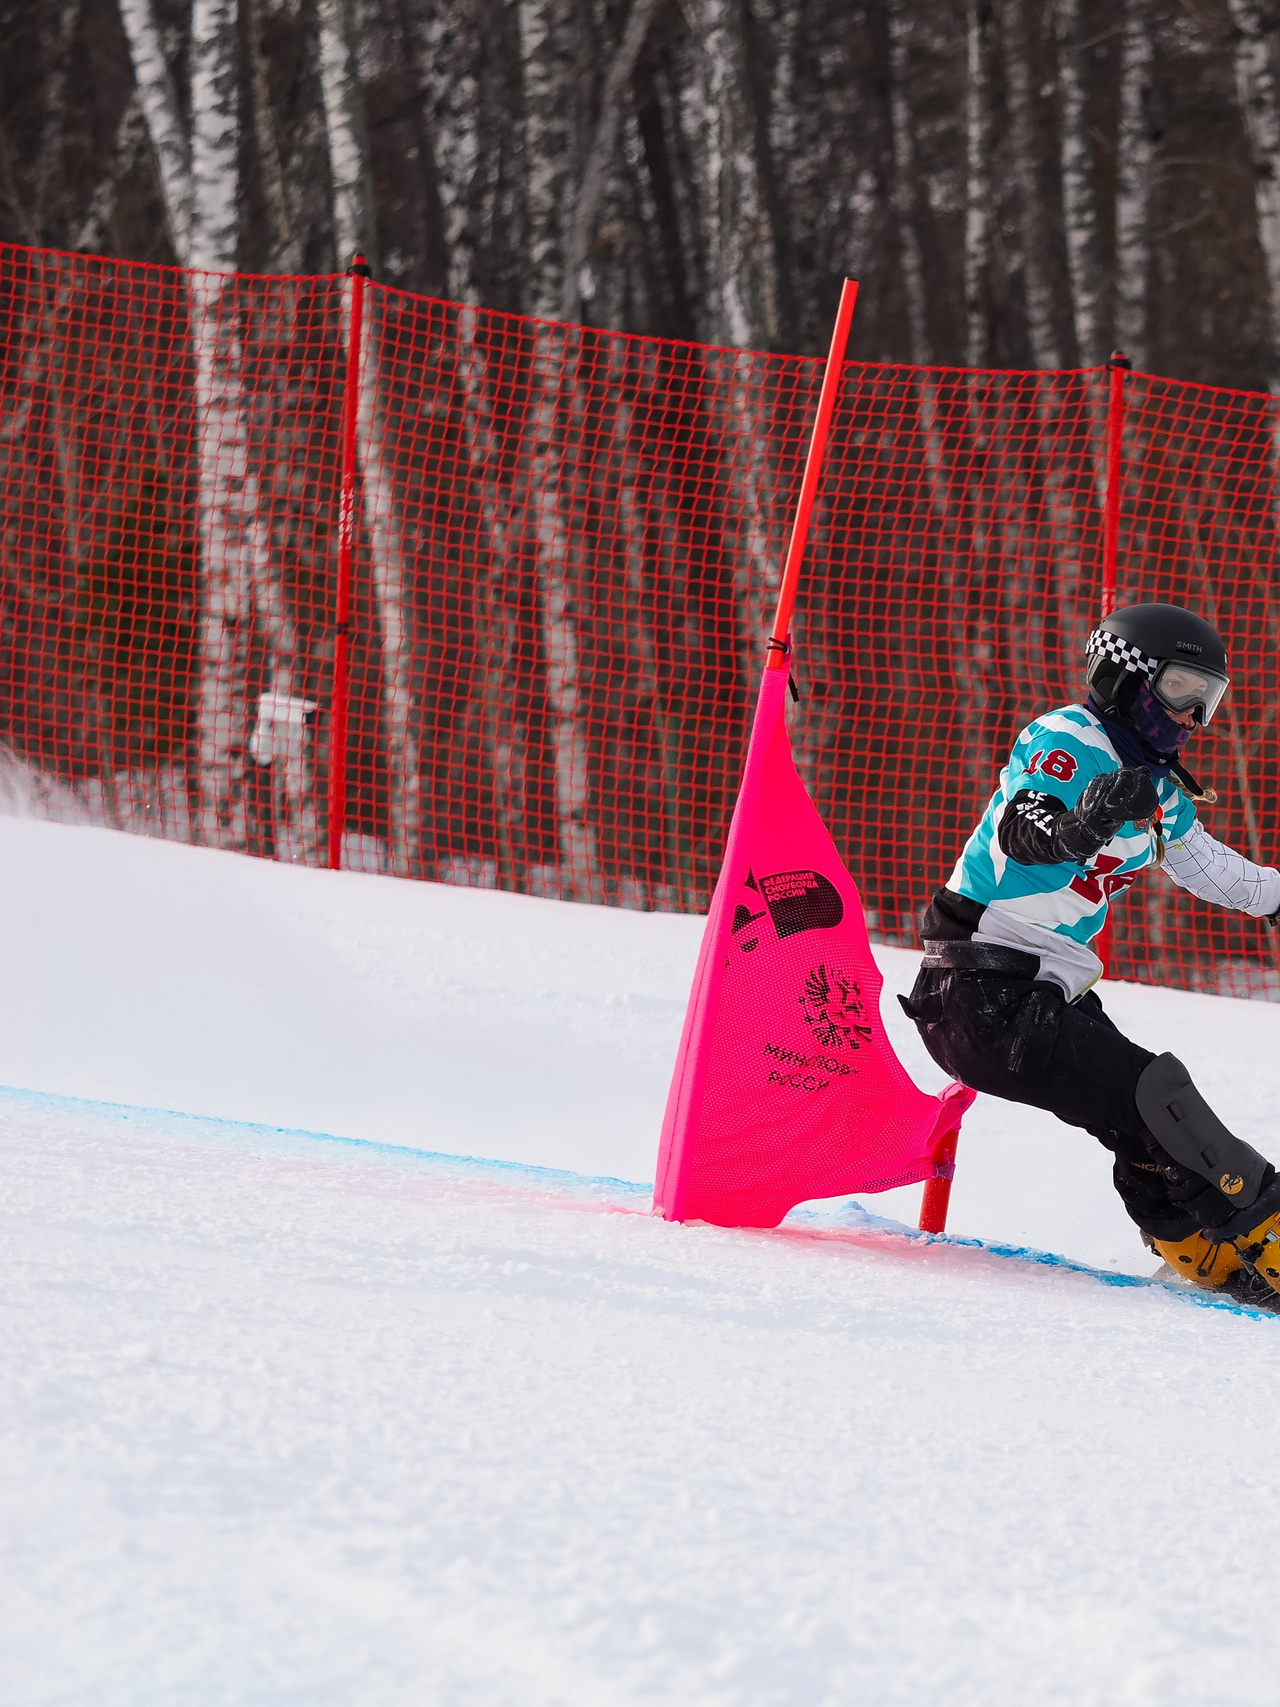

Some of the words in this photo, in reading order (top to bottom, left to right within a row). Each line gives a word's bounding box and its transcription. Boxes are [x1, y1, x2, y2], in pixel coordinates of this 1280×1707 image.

[1176, 640, 1203, 653] SMITH
[763, 872, 815, 887] ФЕДЕРАЦИЯ
[765, 880, 819, 895] СНОУБОРДА
[767, 888, 807, 902] РОССИИ
[763, 1042, 861, 1077] МИНСПОР
